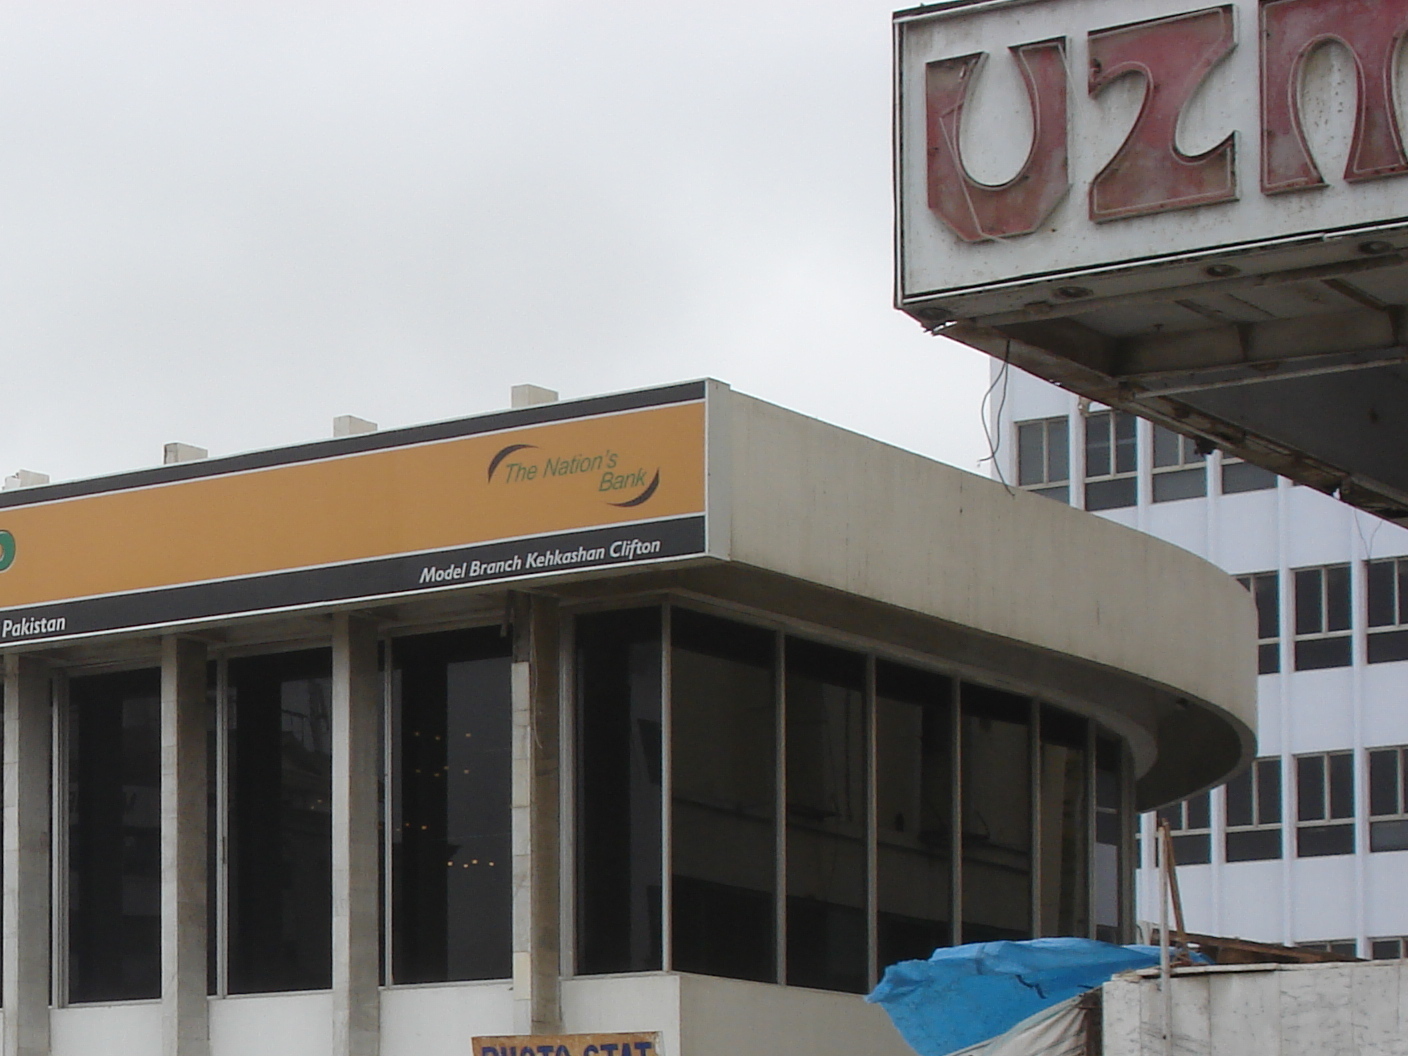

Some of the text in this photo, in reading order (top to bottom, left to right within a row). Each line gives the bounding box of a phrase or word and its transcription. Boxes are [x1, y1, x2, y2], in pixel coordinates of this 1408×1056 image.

[505, 450, 619, 484] The Nation's
[598, 468, 647, 492] Bank
[419, 539, 661, 583] Model Branch Kehkashan Clifton
[2, 616, 66, 638] Pakistan
